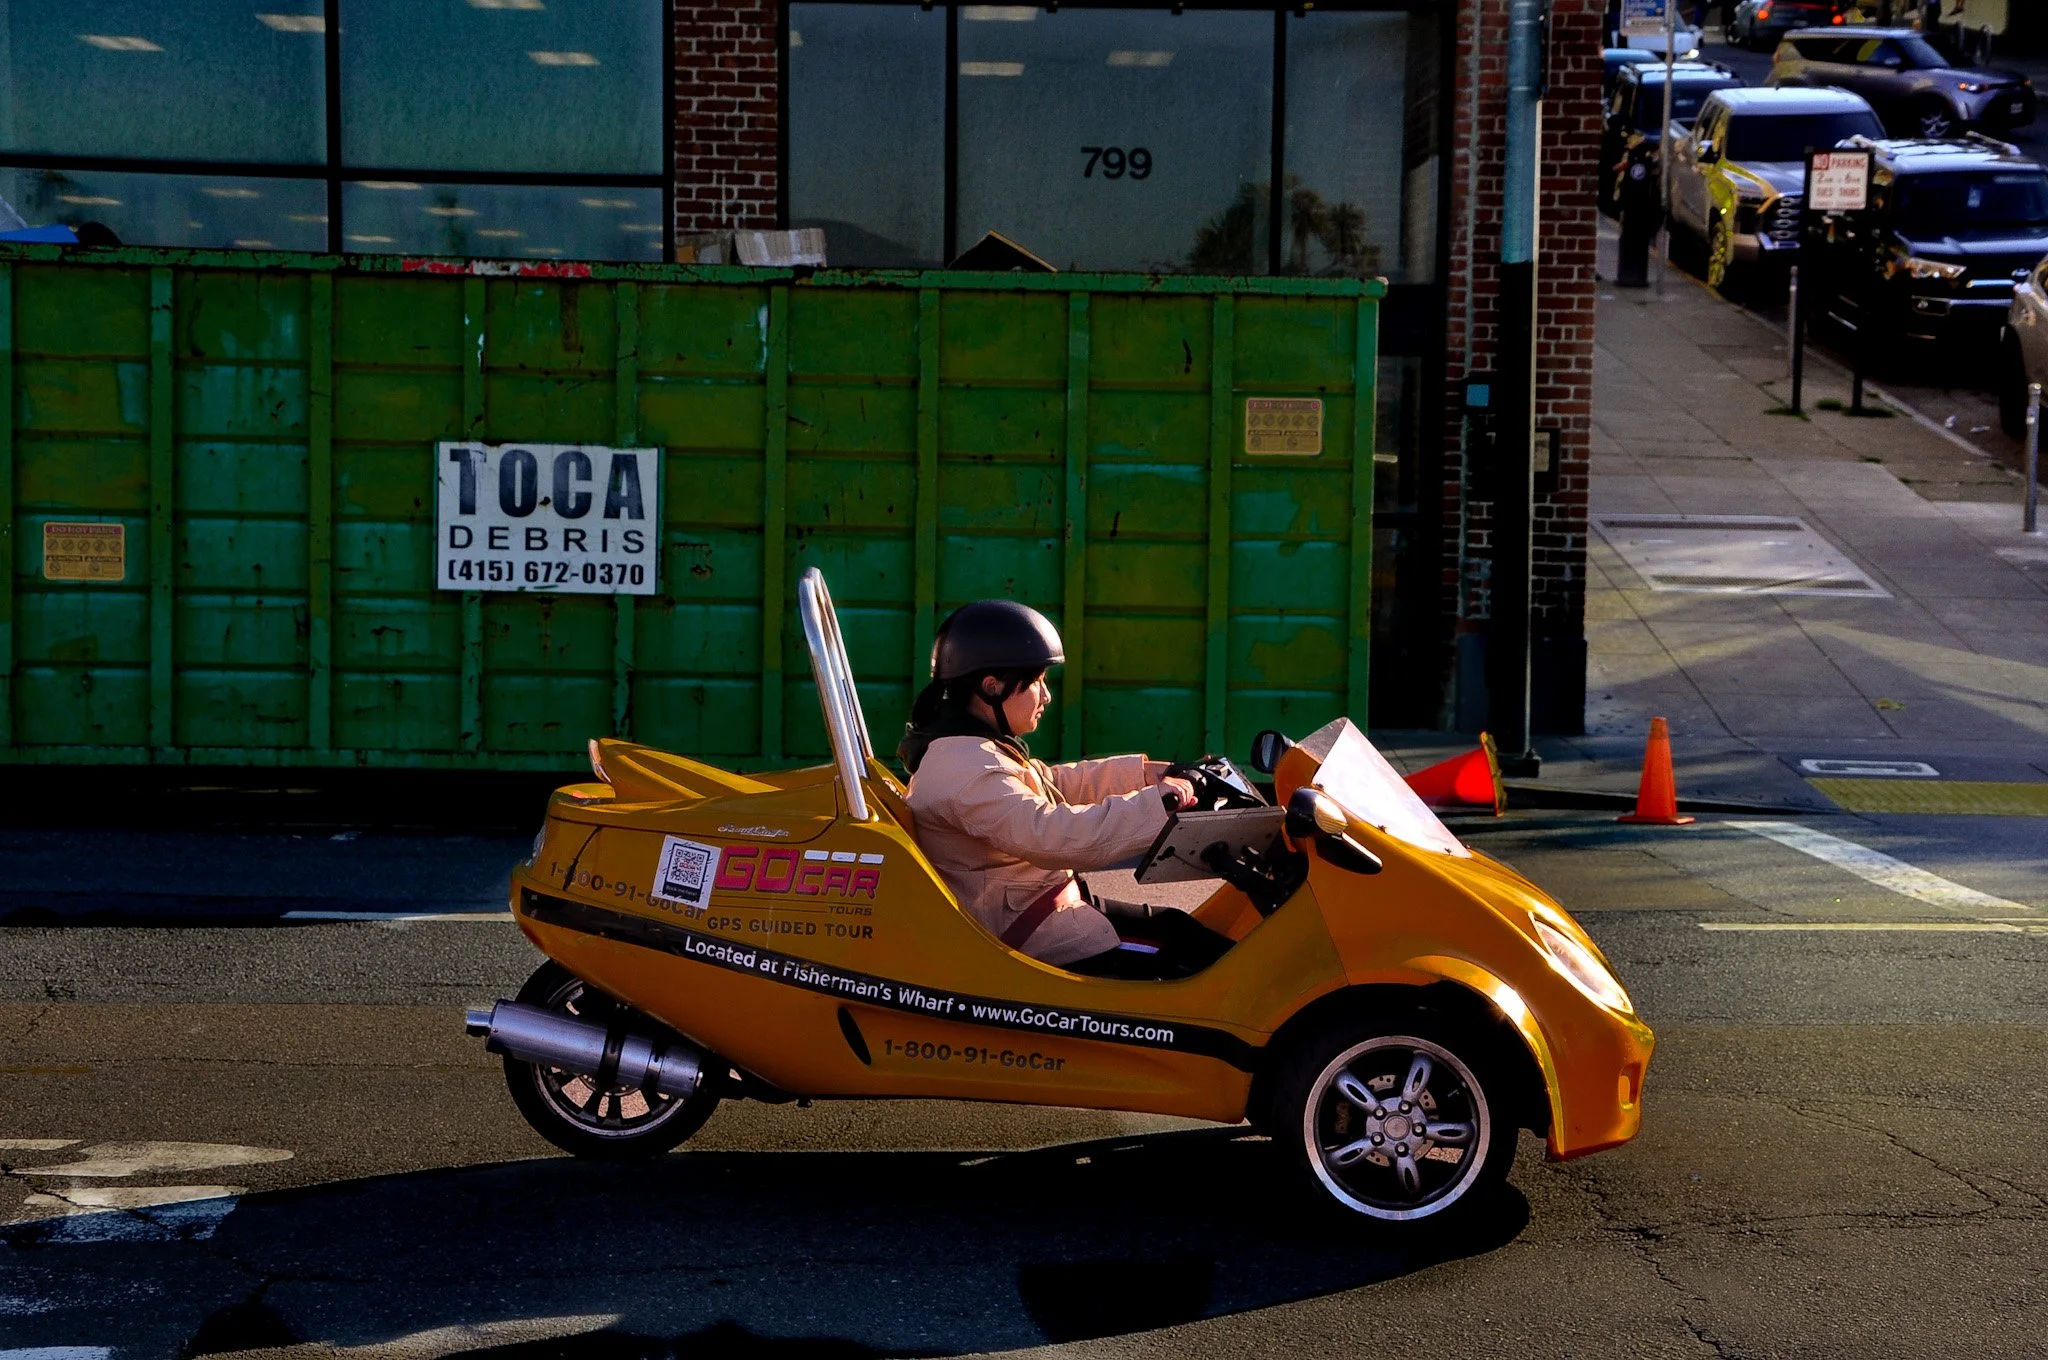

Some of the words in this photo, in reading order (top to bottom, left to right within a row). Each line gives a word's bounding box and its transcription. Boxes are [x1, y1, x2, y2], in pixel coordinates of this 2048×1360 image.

[1081, 147, 1153, 179] 799
[1831, 158, 1866, 169] PARKING
[449, 448, 645, 520] TOCA
[449, 525, 645, 554] DEBRIS
[448, 559, 514, 582] (415)
[524, 561, 644, 585] 672-0370
[828, 905, 873, 916] TOURS
[707, 916, 742, 931] GPS
[750, 918, 817, 936] GUIDED
[824, 922, 874, 939] TOUR
[685, 936, 756, 968] Located
[760, 957, 778, 974] at
[783, 961, 893, 1001] Fisherman's
[899, 986, 955, 1014] Wharf
[972, 1003, 1175, 1043] www.GoCarTours.com
[884, 1038, 1067, 1071] 1-800-91-GoCar
